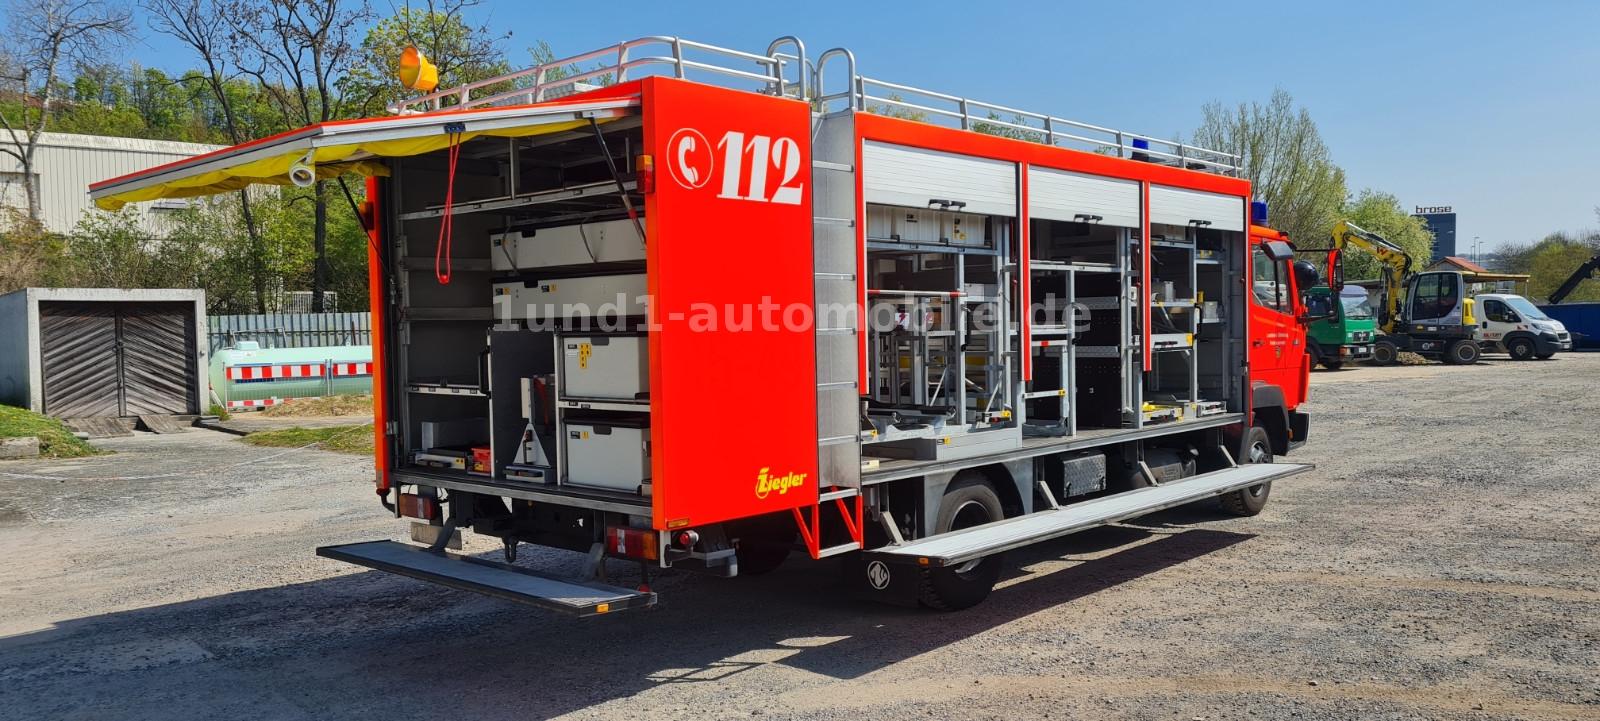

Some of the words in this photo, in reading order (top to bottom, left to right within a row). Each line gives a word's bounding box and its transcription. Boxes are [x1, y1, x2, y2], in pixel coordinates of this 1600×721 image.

[717, 131, 803, 205] 112
[1416, 205, 1452, 214] brose
[756, 467, 807, 498] Ziegler
